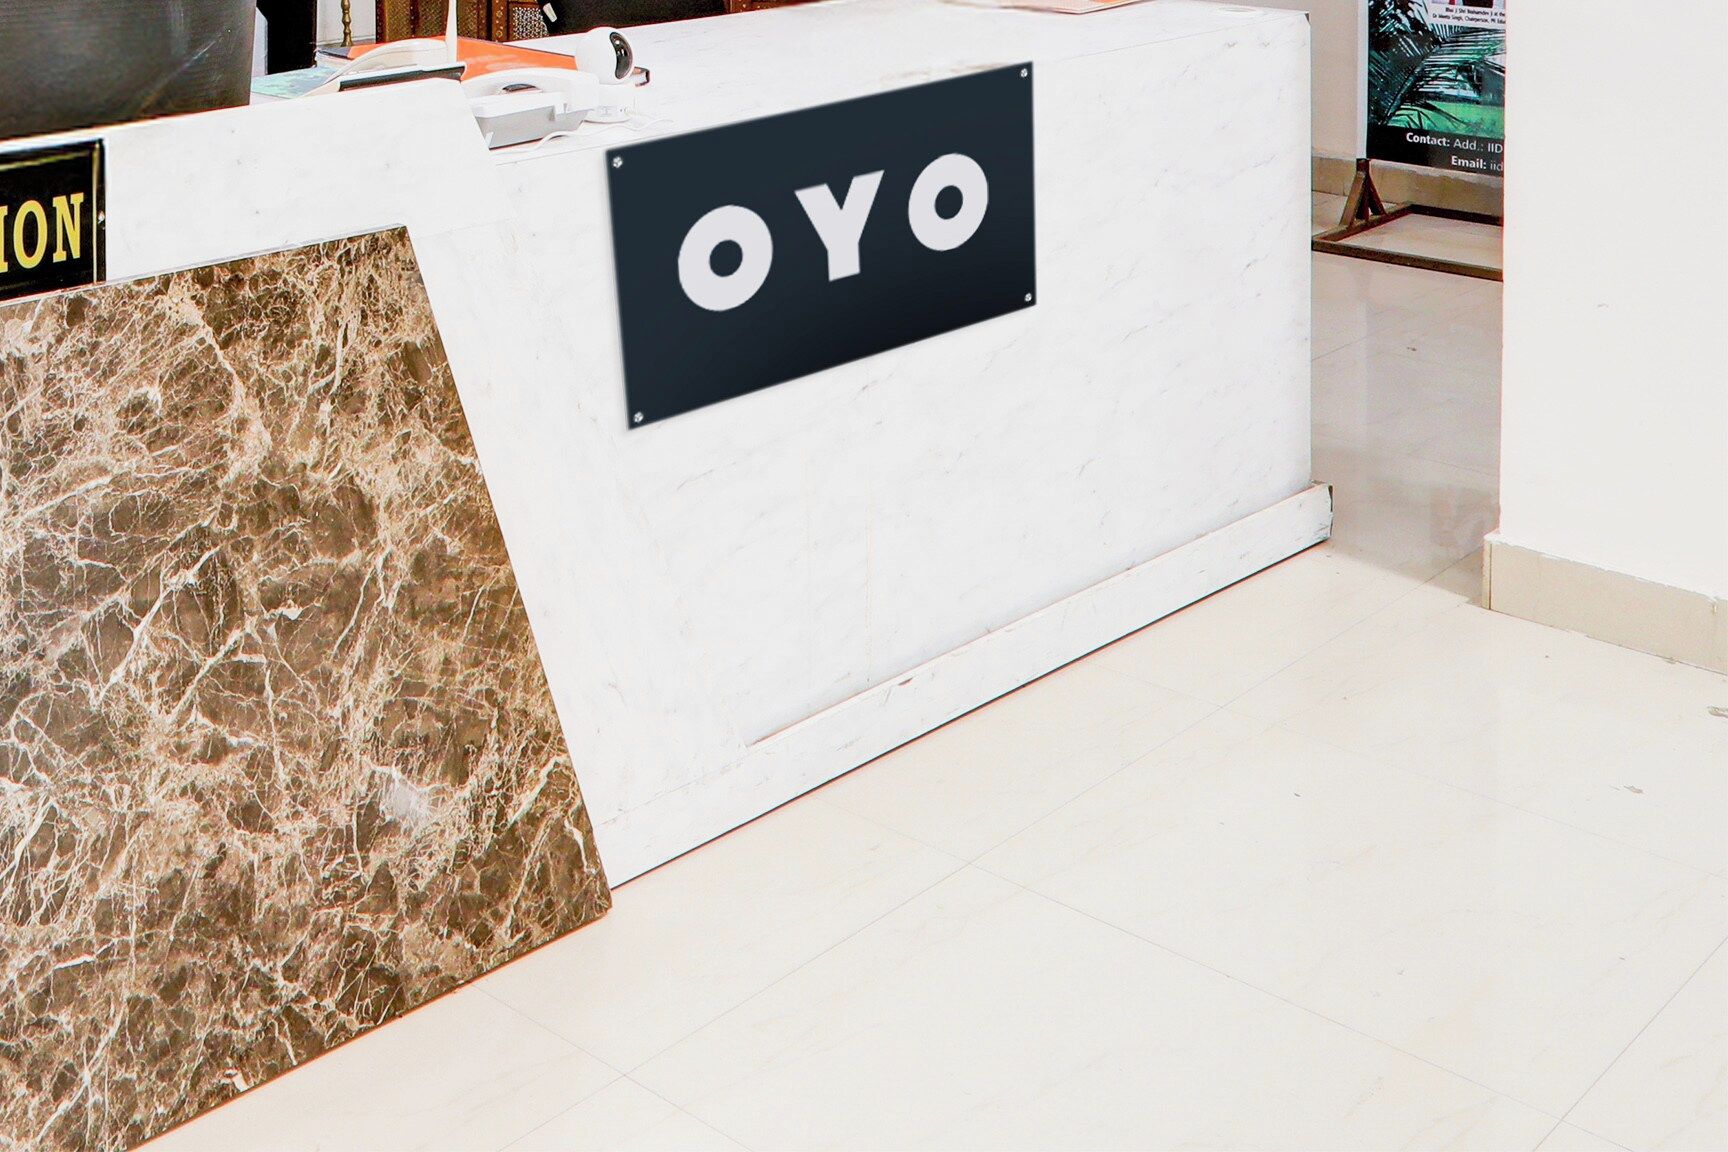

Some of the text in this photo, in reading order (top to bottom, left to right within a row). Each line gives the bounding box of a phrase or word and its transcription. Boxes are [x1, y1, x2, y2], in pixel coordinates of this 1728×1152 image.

[1406, 132, 1450, 147] Contact:
[1451, 155, 1487, 170] Email:
[677, 152, 989, 312] OYO
